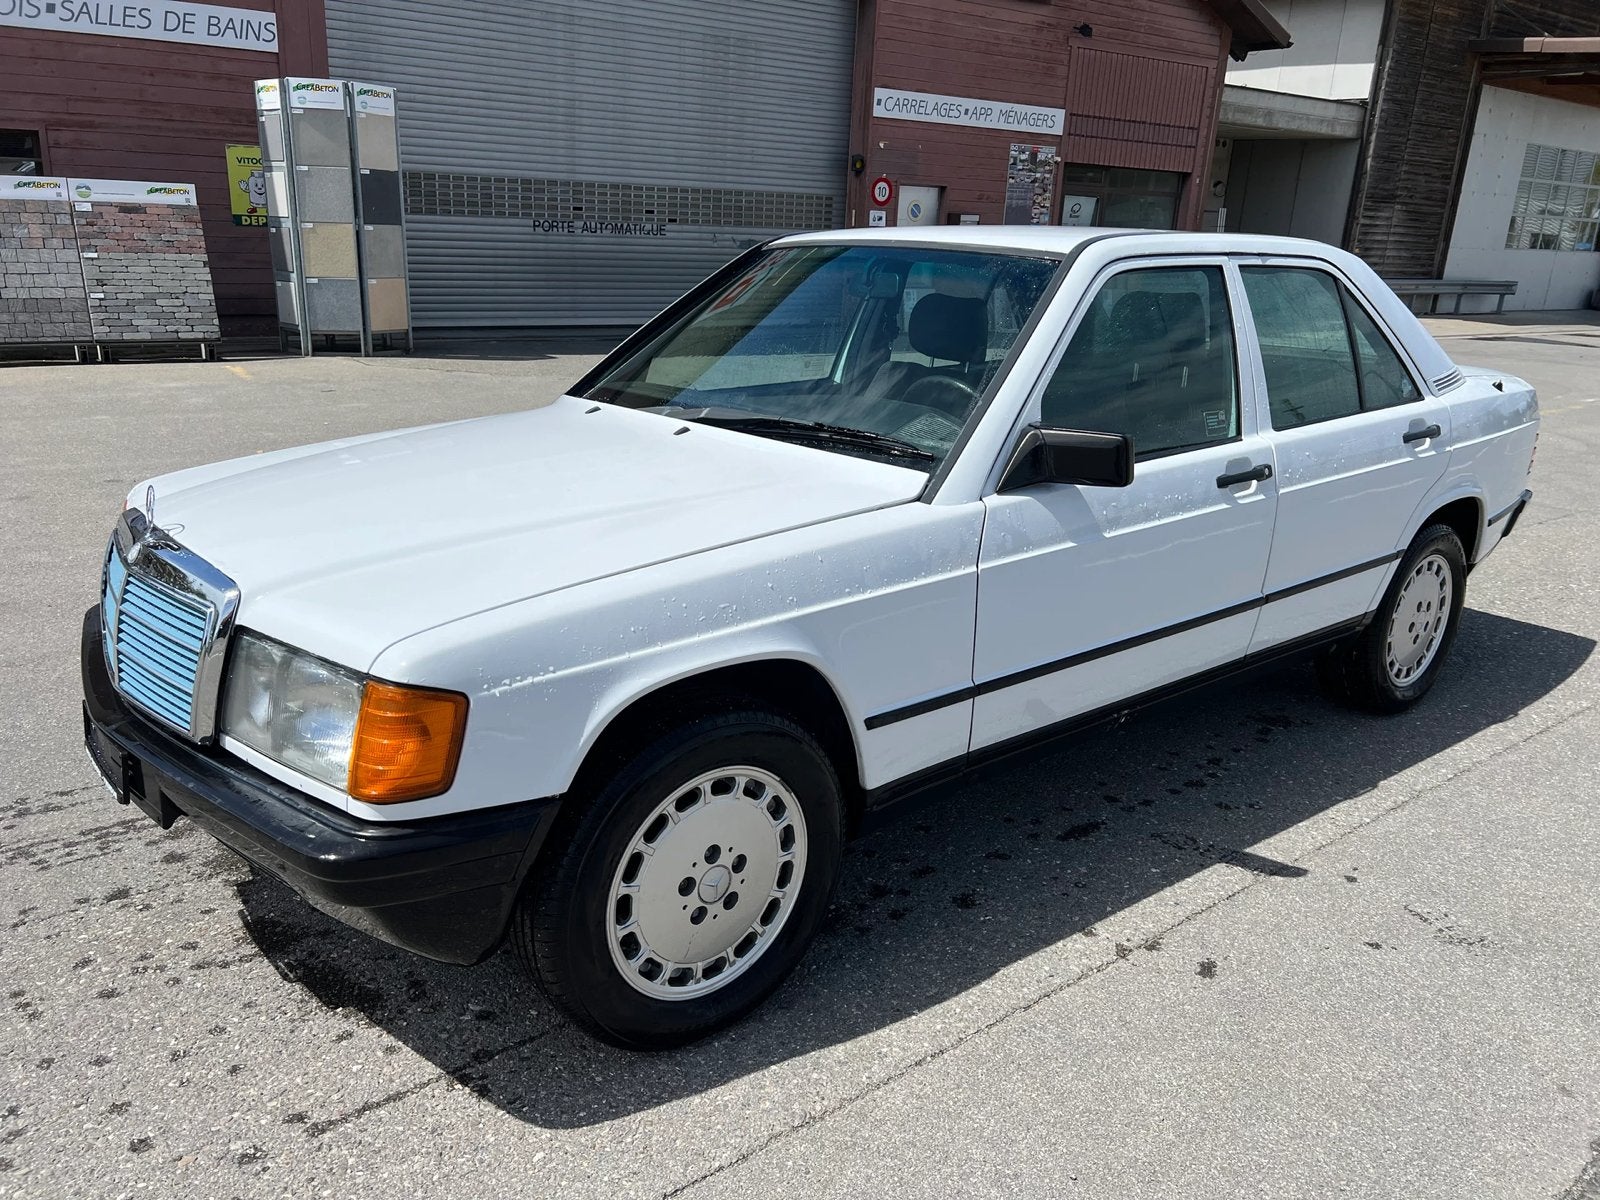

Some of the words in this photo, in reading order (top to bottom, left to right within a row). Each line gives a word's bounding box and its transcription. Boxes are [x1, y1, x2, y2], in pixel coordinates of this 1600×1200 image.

[59, 0, 152, 29] SALLES
[163, 10, 197, 34] DE
[206, 15, 277, 43] BAINS
[884, 96, 963, 119] CARRELAGES
[969, 106, 993, 123] APP.
[997, 107, 1057, 129] MÉNAGERS
[878, 186, 887, 198] 10
[532, 219, 575, 234] PORTE
